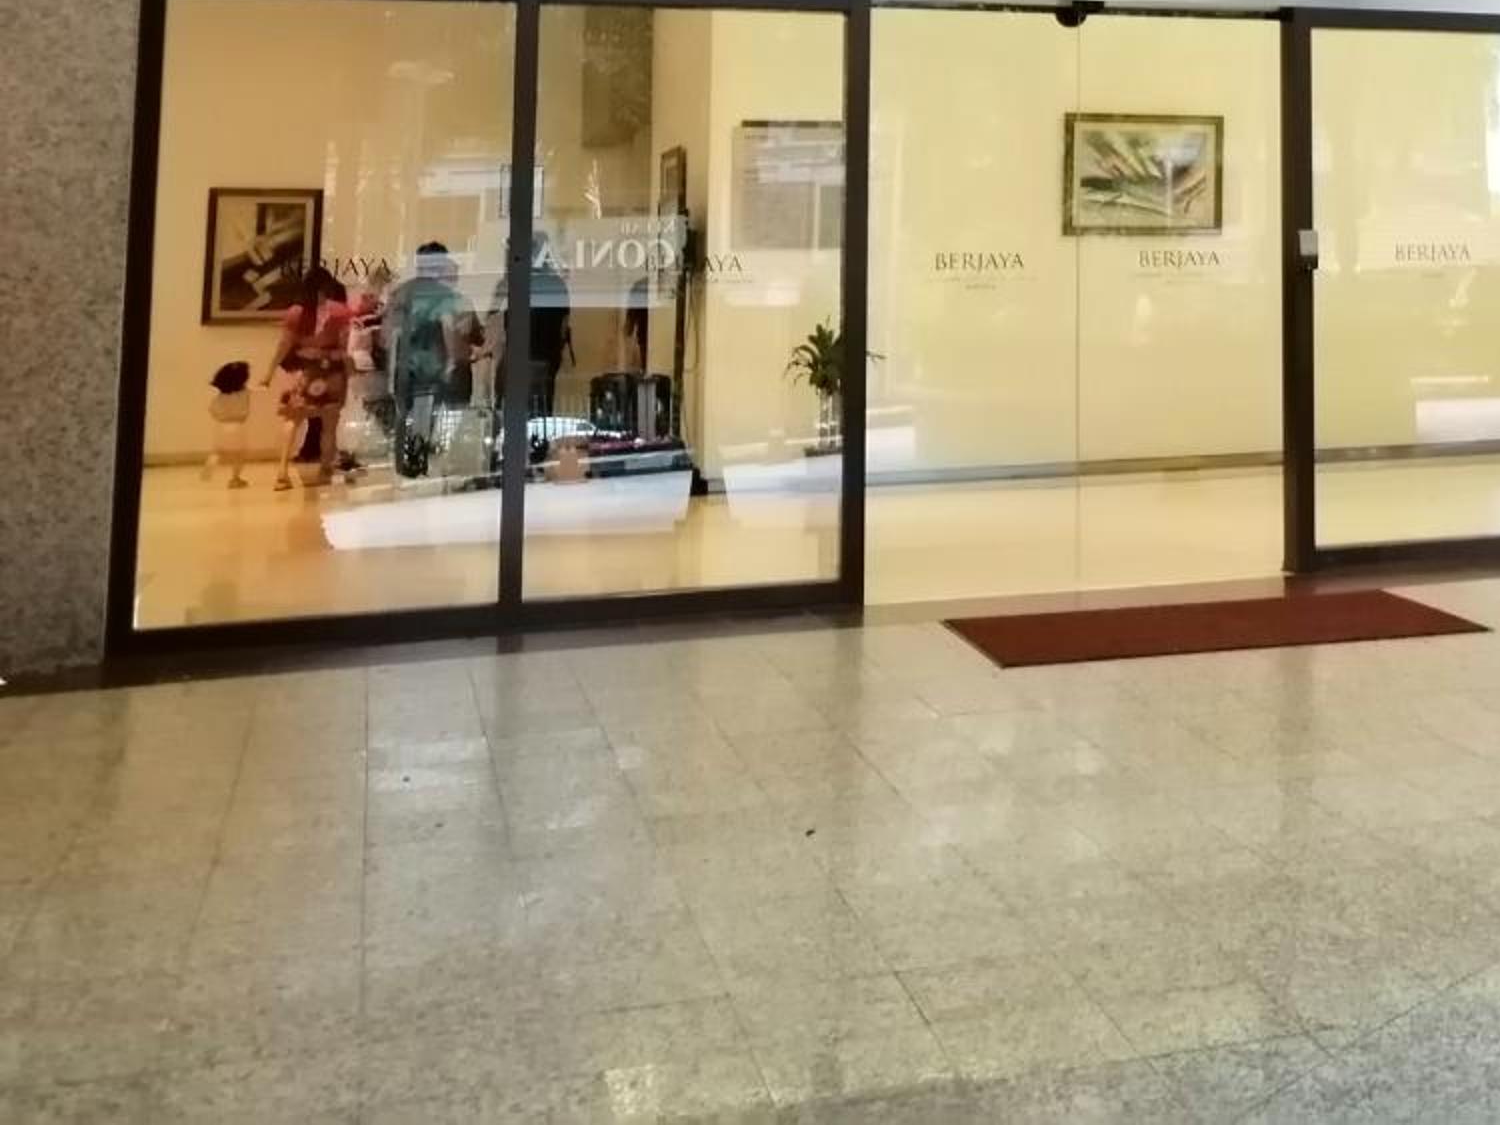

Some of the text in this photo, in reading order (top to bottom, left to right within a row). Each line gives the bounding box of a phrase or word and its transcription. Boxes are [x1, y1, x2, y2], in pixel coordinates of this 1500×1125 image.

[934, 251, 1025, 273] BERJAYA
[1138, 250, 1220, 269] BERJAYA
[1394, 243, 1471, 263] BERJAYA
